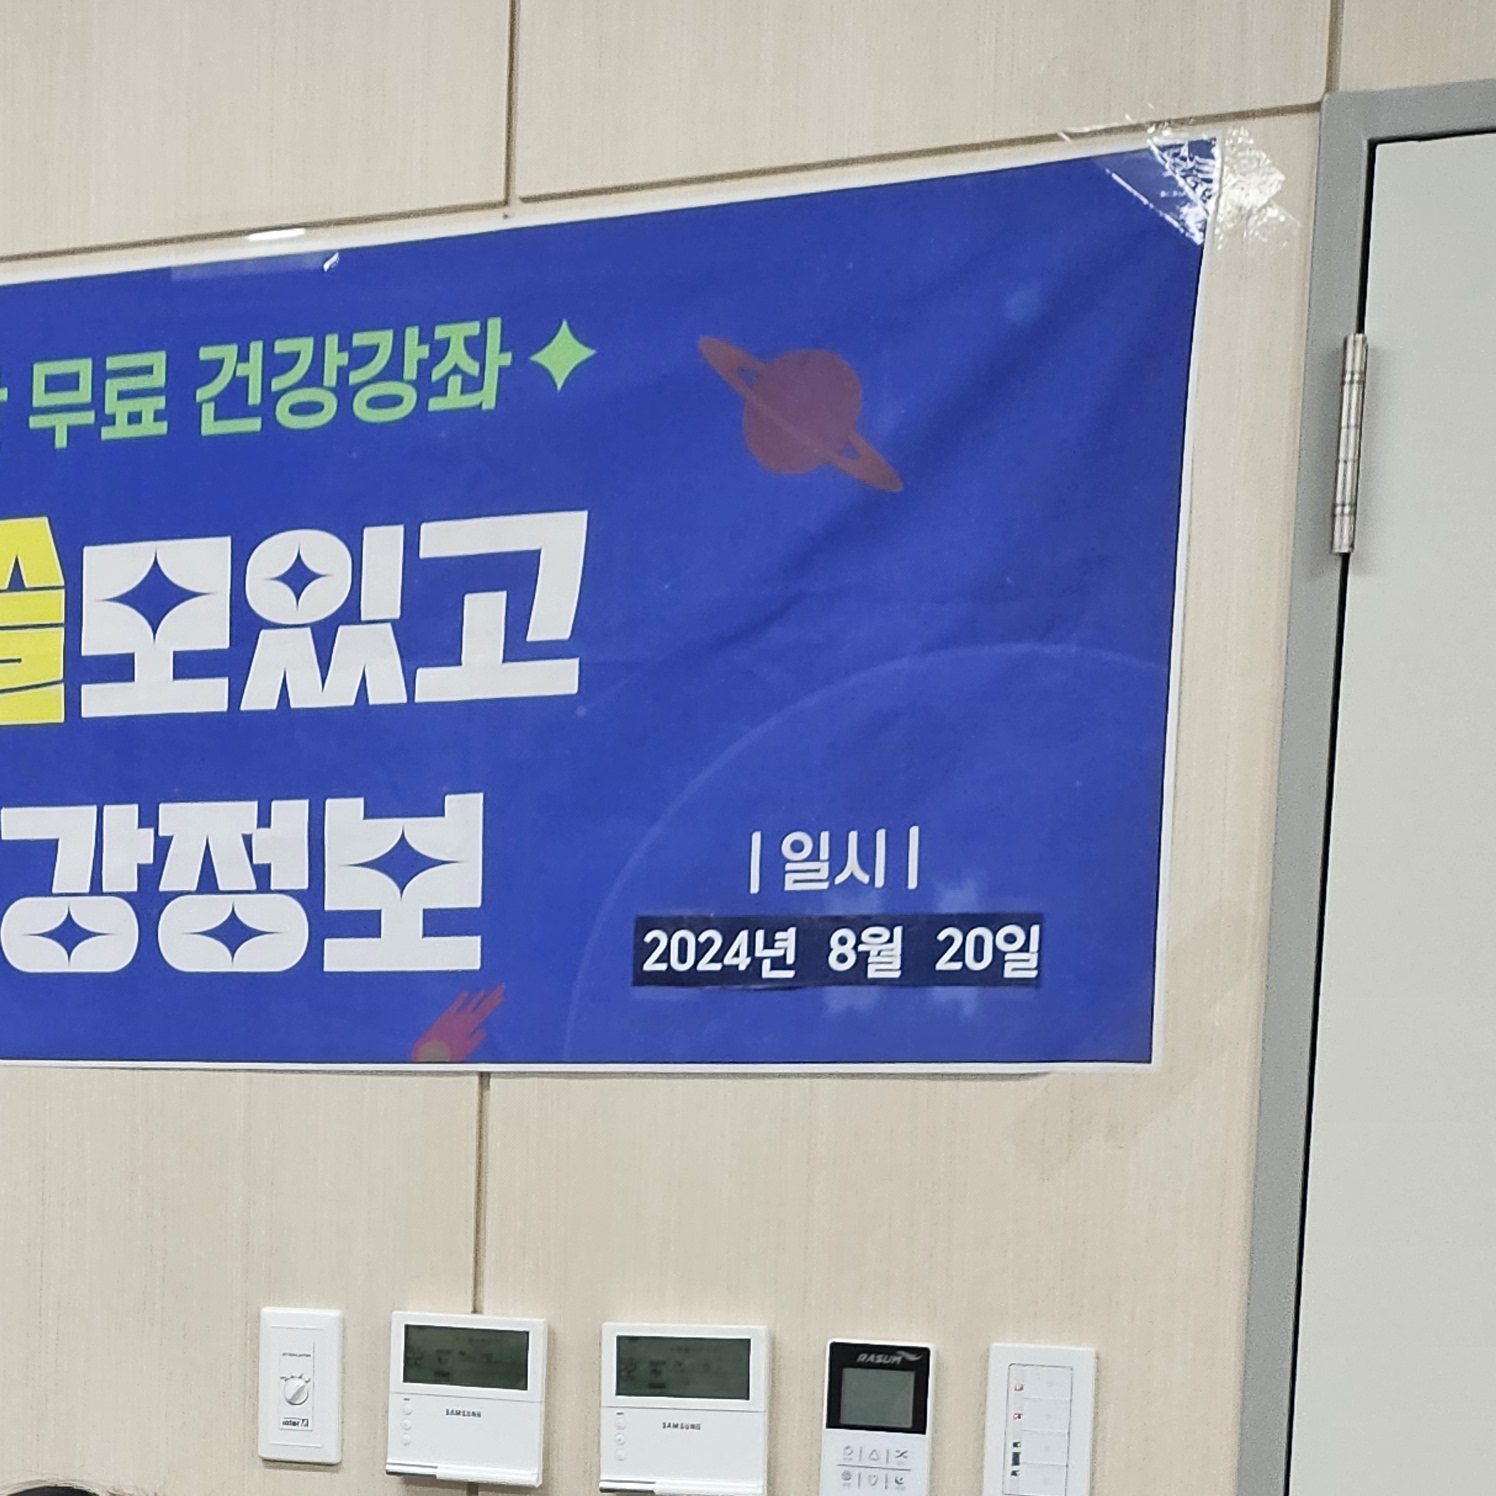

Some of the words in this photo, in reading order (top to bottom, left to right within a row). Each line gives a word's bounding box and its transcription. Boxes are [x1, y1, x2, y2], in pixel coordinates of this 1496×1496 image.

[28, 349, 168, 449] 무료
[194, 316, 513, 436] 건강강좌
[642, 926, 797, 979] 2024년
[827, 925, 903, 979] 8월
[935, 924, 1040, 979] 20일
[662, 1422, 701, 1430] SAMSUNG
